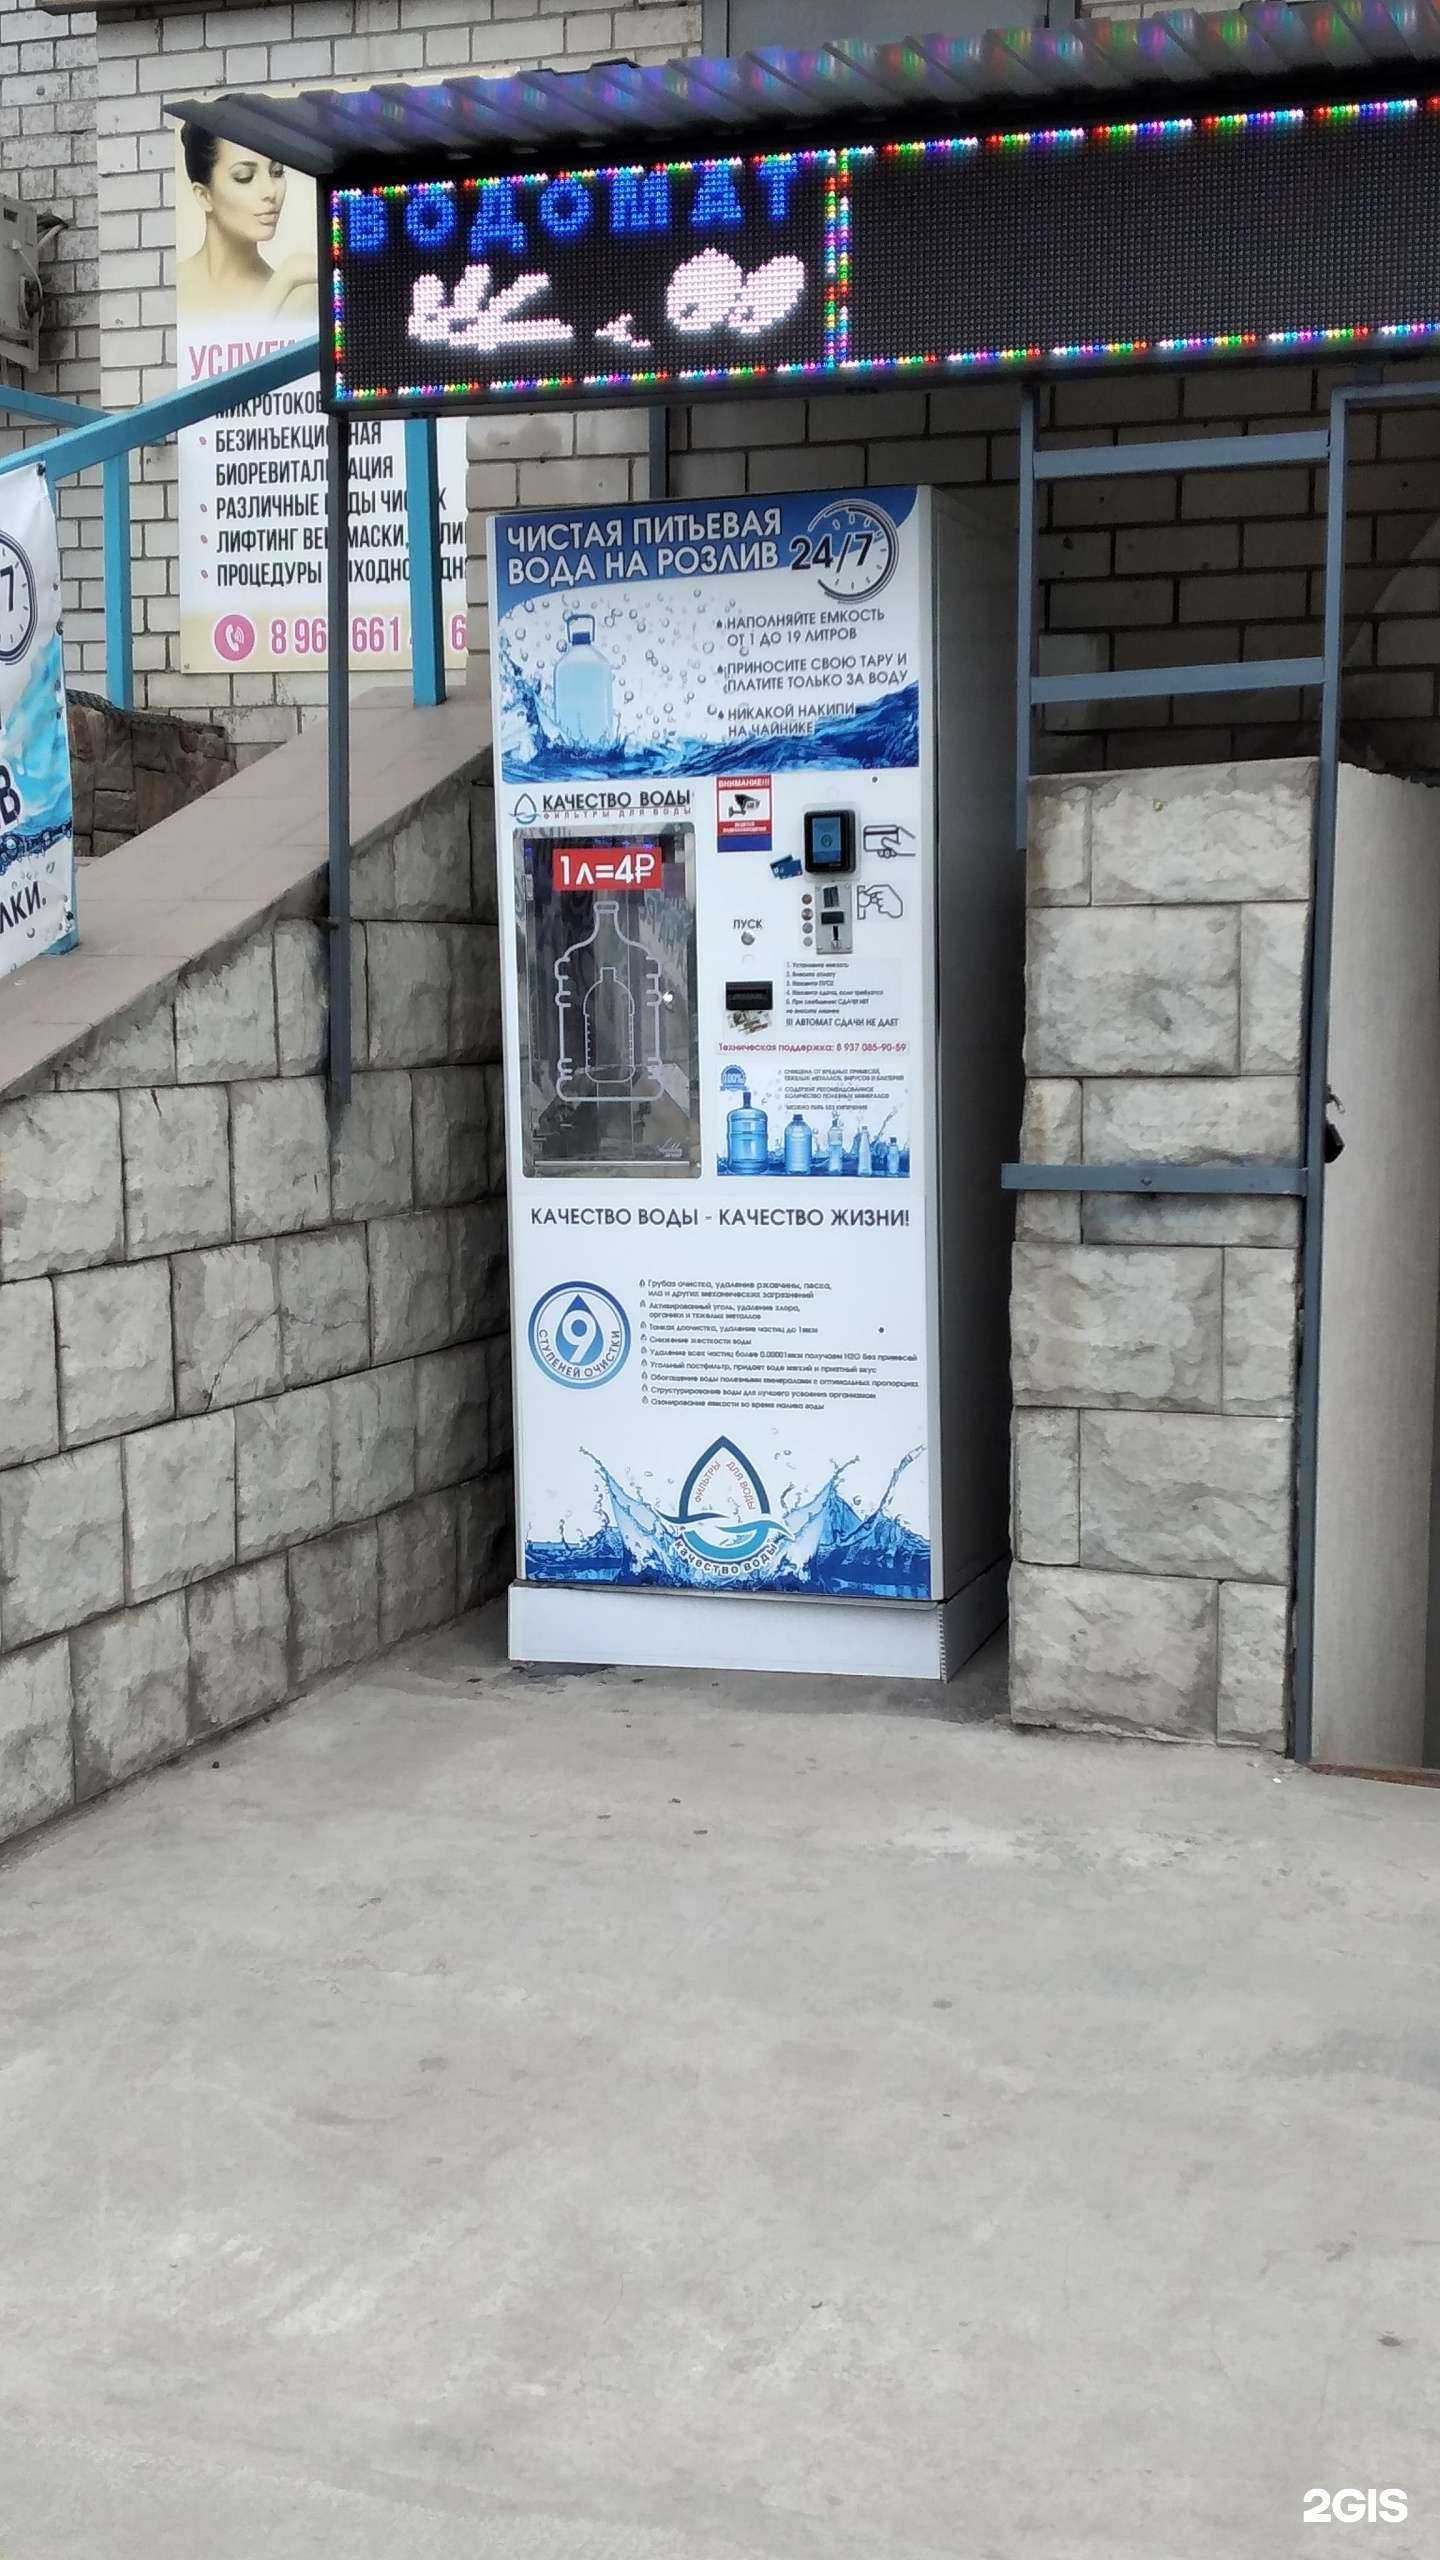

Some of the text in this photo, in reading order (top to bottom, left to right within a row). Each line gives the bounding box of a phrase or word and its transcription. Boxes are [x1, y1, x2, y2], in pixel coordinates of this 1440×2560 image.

[348, 159, 799, 258] ВОДОМАТ
[215, 421, 382, 452] БЕЗИНЪЕКЦИНАЯ
[215, 456, 393, 486] БИОРЕВИТАЛАЦИЯ
[216, 493, 319, 519] РАЗЛИЧНЫЕ
[216, 527, 298, 553] ЛИФТИНГ
[507, 508, 782, 553] ЧИСТАЯ ПИТЬЕВАЯ
[789, 532, 876, 573] 24/7
[216, 562, 322, 587] ПРОЦЕДУРЫ
[507, 543, 779, 588] ВОДА НА РОЗЛИВ
[727, 608, 885, 629] НАПОЛНЯЙТЕ ЕМКОСТЬ
[271, 614, 466, 654] 8 96 661 6
[727, 628, 858, 648] ОТ 1 ДО 19 ЛИТРОВ
[727, 653, 907, 675] ПРИНОСИТЕ СВОЮ ТАРУ И
[727, 670, 908, 692] ПЛАТИТЕ ТОЛЬКО ЗА ВОДУ
[727, 702, 855, 721] НИКАКОЙ НАКИПИ
[727, 721, 813, 737] НА ЧАЙНИКЕ
[543, 789, 690, 811] КАЧЕСТВО ВОДЫ
[733, 919, 762, 930] ПУСК
[795, 1018, 832, 1026] АВТОМАТ
[834, 1018, 864, 1027] СДАЧИ
[866, 1018, 876, 1026] НЕ
[719, 1043, 776, 1052] Техническая
[531, 1207, 632, 1225] КАЧЕСТВО
[638, 1208, 698, 1228] ВОДЫ
[719, 1208, 824, 1226] КАЧЕСТВО
[831, 1208, 910, 1227] ЖИЗНИ!
[562, 1309, 597, 1363] 9
[539, 1329, 620, 1378] СТУПЕНЕЙ ОЧИСТКИ
